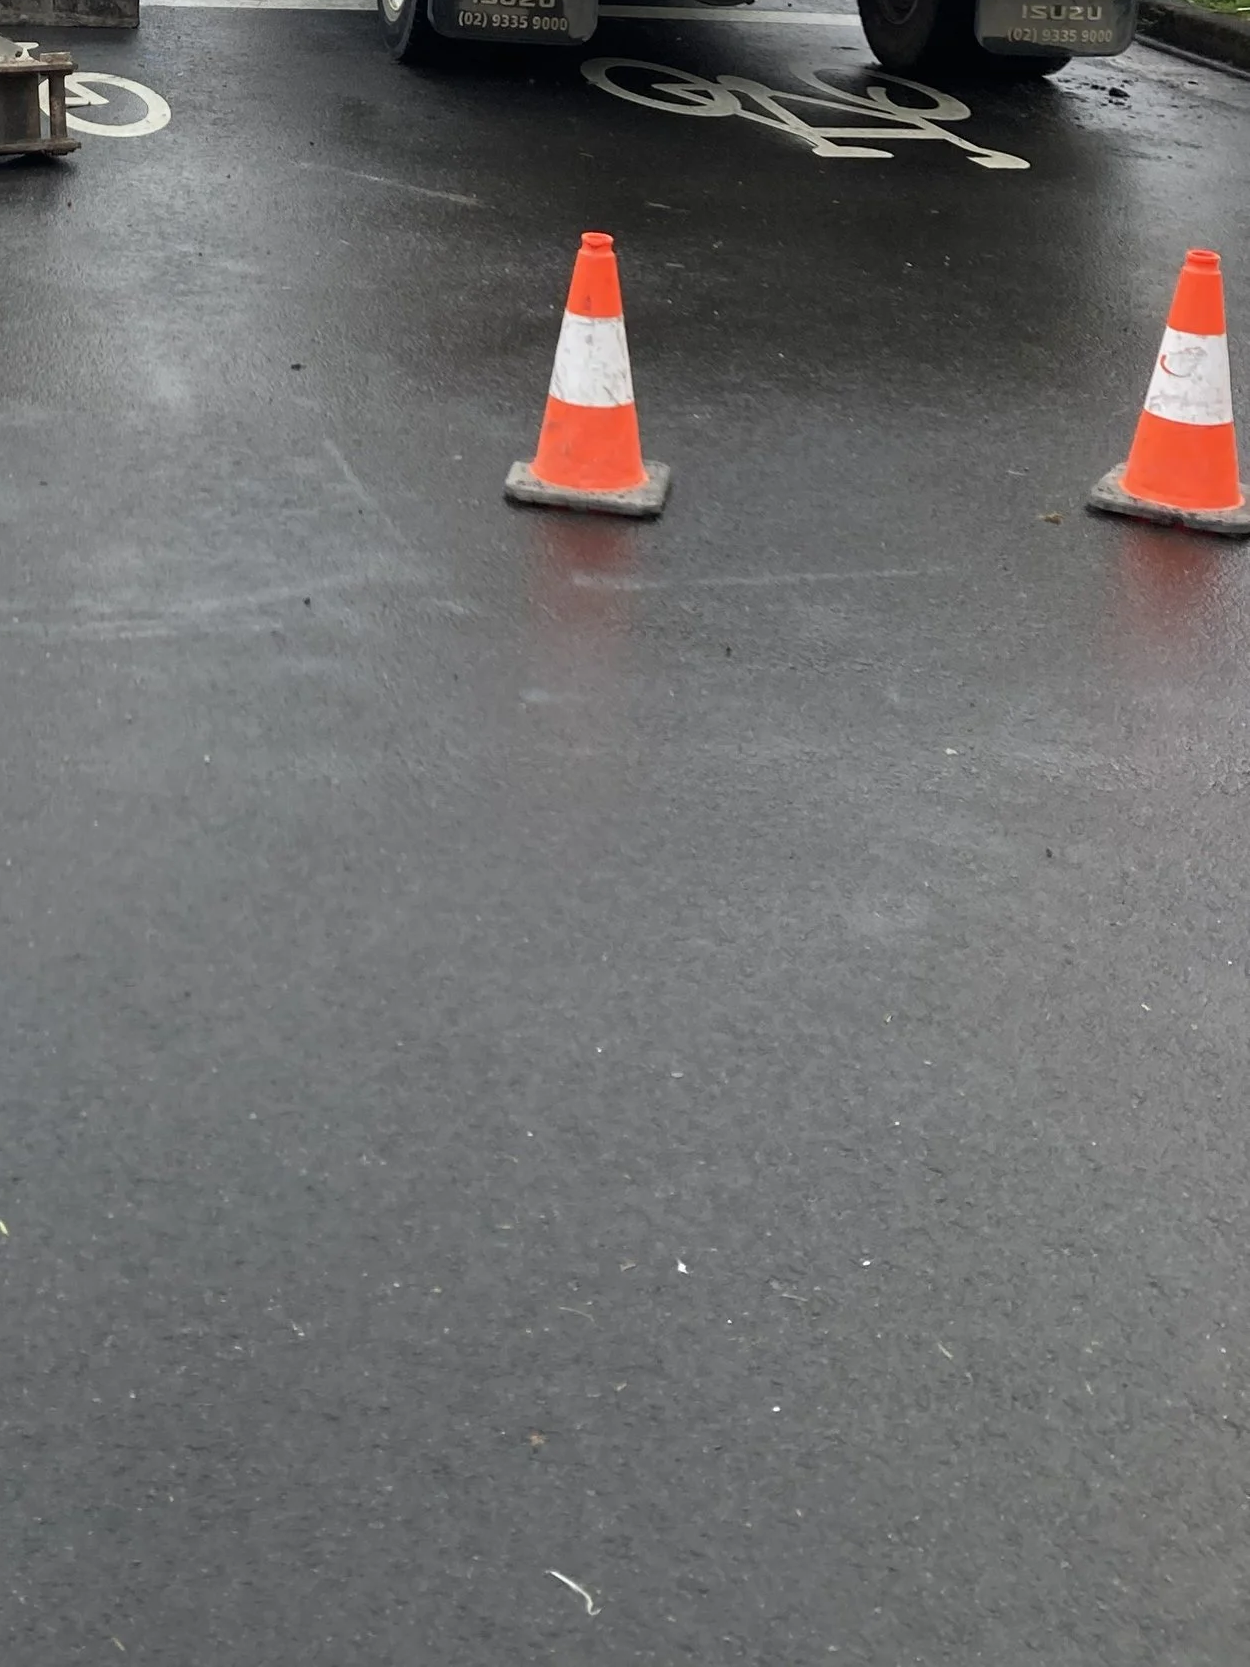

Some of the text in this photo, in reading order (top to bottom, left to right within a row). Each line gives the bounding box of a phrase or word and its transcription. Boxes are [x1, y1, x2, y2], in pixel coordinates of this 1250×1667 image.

[458, 11, 568, 31] (02) 9335 9000
[1021, 4, 1103, 21] ISUZU
[1007, 27, 1113, 43] (02) 9335 9000
